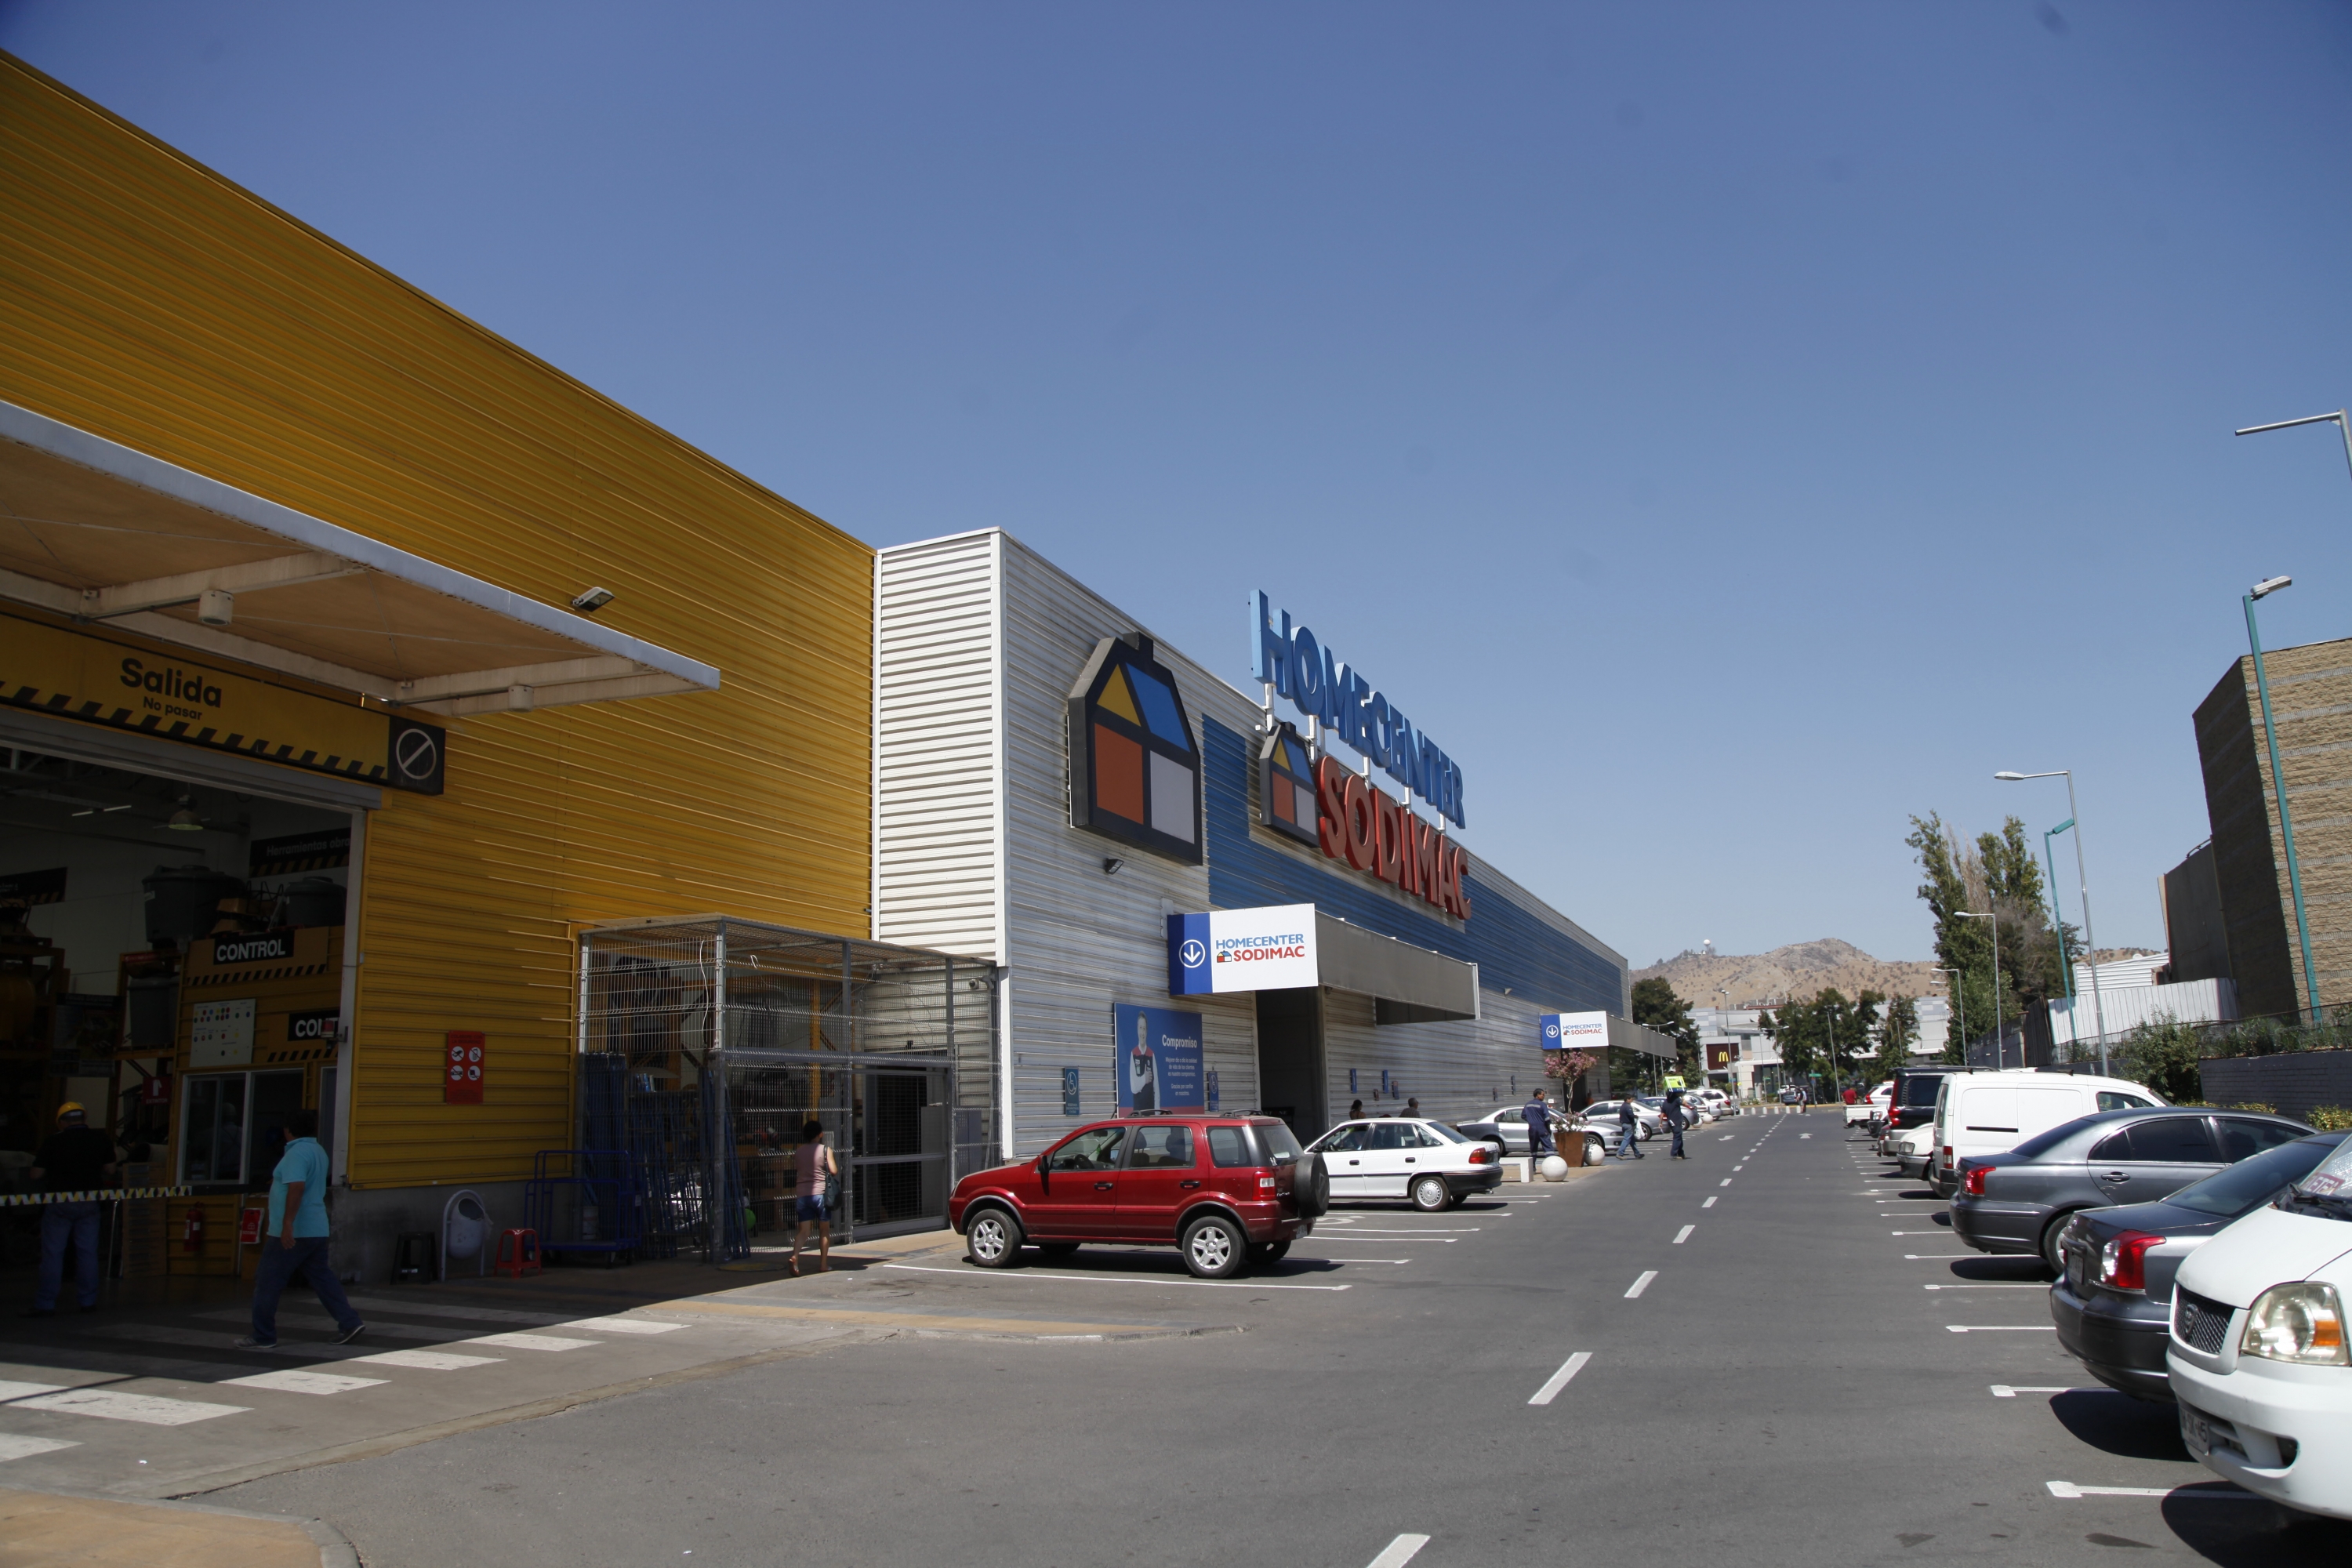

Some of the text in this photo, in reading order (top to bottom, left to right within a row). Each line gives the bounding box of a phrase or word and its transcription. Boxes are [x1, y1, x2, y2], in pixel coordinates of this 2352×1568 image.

[120, 657, 222, 709] Salida
[143, 696, 202, 720] No pasar
[1250, 589, 1465, 829] HOMECENTER
[266, 840, 328, 857] Herramientas
[1315, 755, 1472, 920] SODIMAC
[216, 938, 286, 962] CONTROL
[1216, 933, 1305, 949] HOMECENTER
[1233, 946, 1305, 962] SODIMAC
[1162, 1034, 1197, 1050] Compromiso
